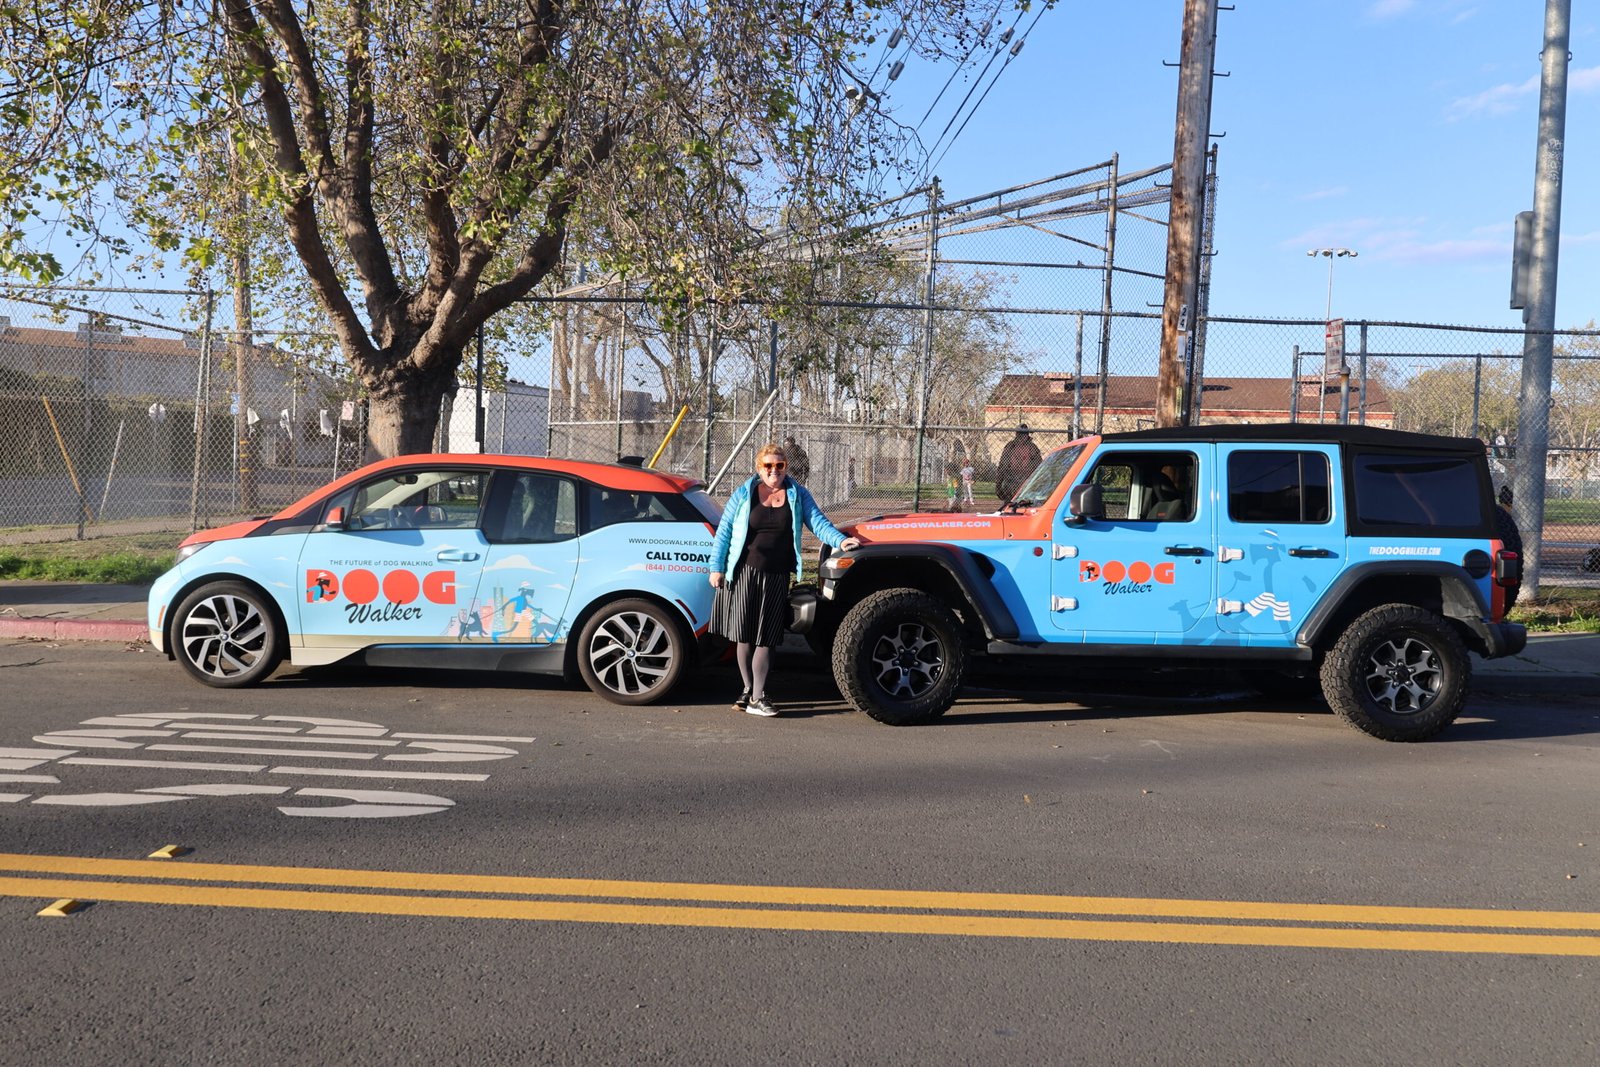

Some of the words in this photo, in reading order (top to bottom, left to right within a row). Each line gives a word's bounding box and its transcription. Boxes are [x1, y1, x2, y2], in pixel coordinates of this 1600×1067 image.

[865, 521, 991, 530] THEDOOGWALKER.COM
[646, 551, 672, 561] CALL
[674, 552, 711, 563] TODAY
[645, 564, 665, 572] (844)
[667, 565, 694, 573] DOOG
[696, 566, 710, 574] DO
[1080, 560, 1175, 585] DOOG
[306, 569, 456, 605] DOOG
[1102, 581, 1152, 595] Walker
[344, 600, 423, 624] Walker
